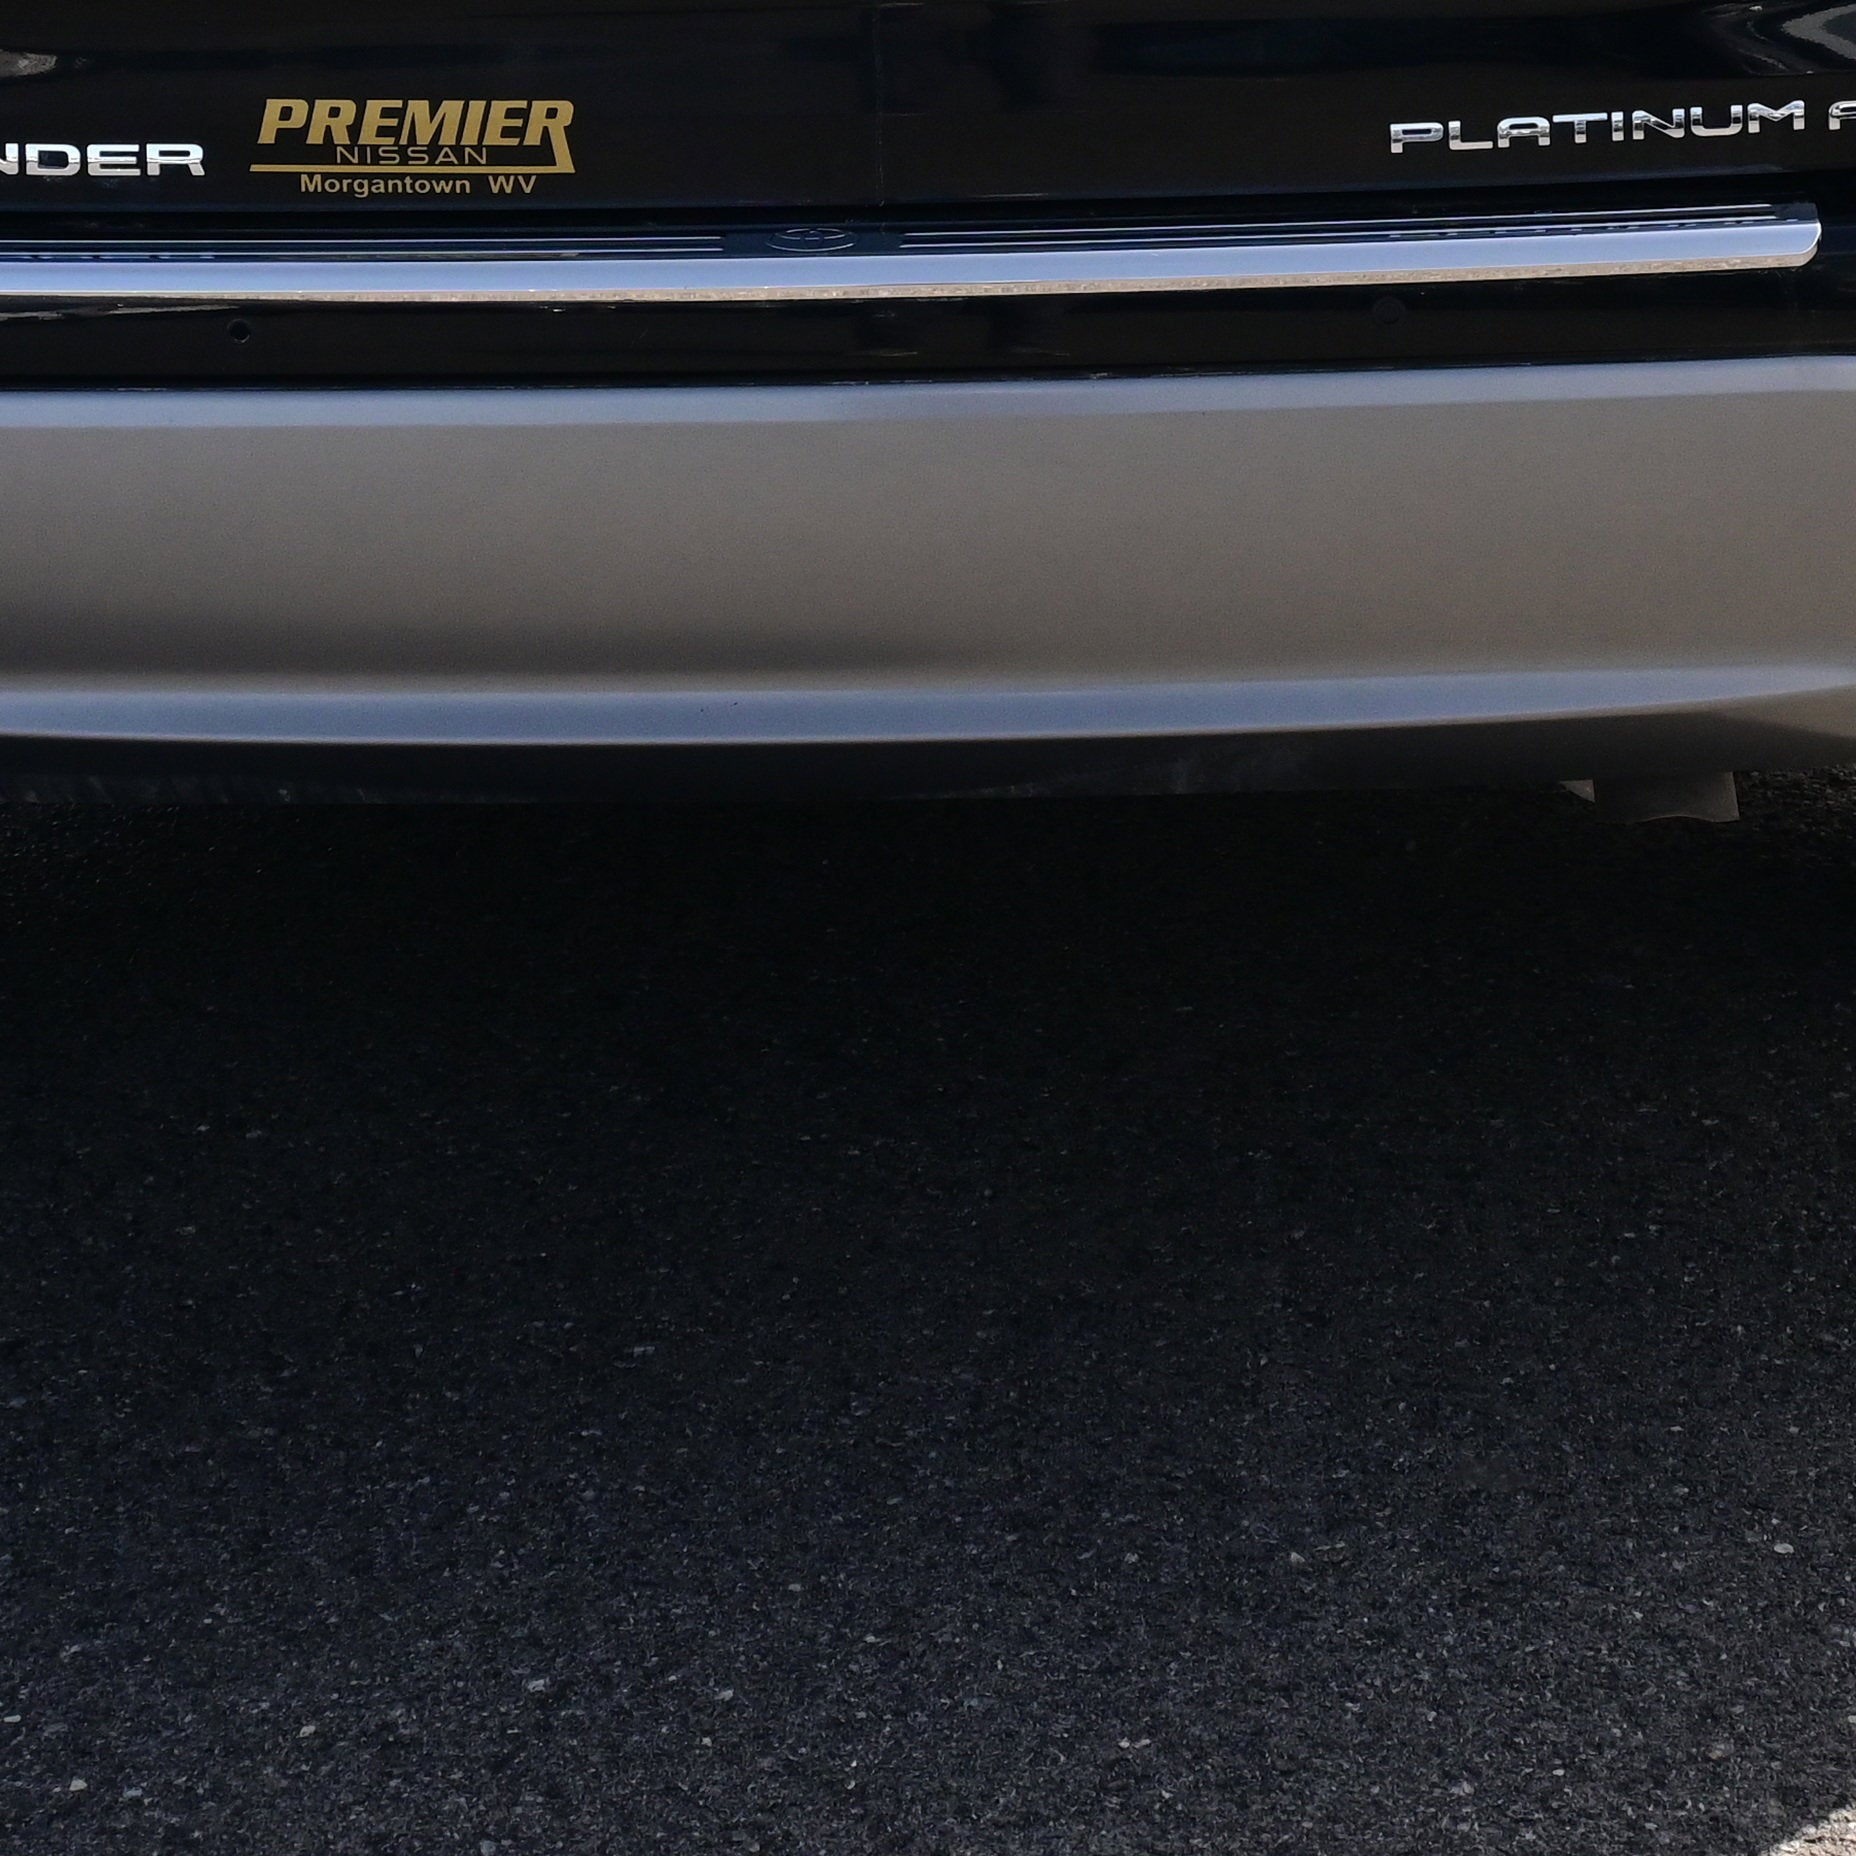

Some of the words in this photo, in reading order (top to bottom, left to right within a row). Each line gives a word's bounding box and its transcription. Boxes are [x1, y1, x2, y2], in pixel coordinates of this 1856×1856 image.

[256, 98, 575, 173] PREMIER
[1389, 99, 1806, 154] PLATINUM
[336, 146, 488, 165] NISSAN
[300, 174, 471, 199] Morgantown
[487, 174, 537, 194] WV
